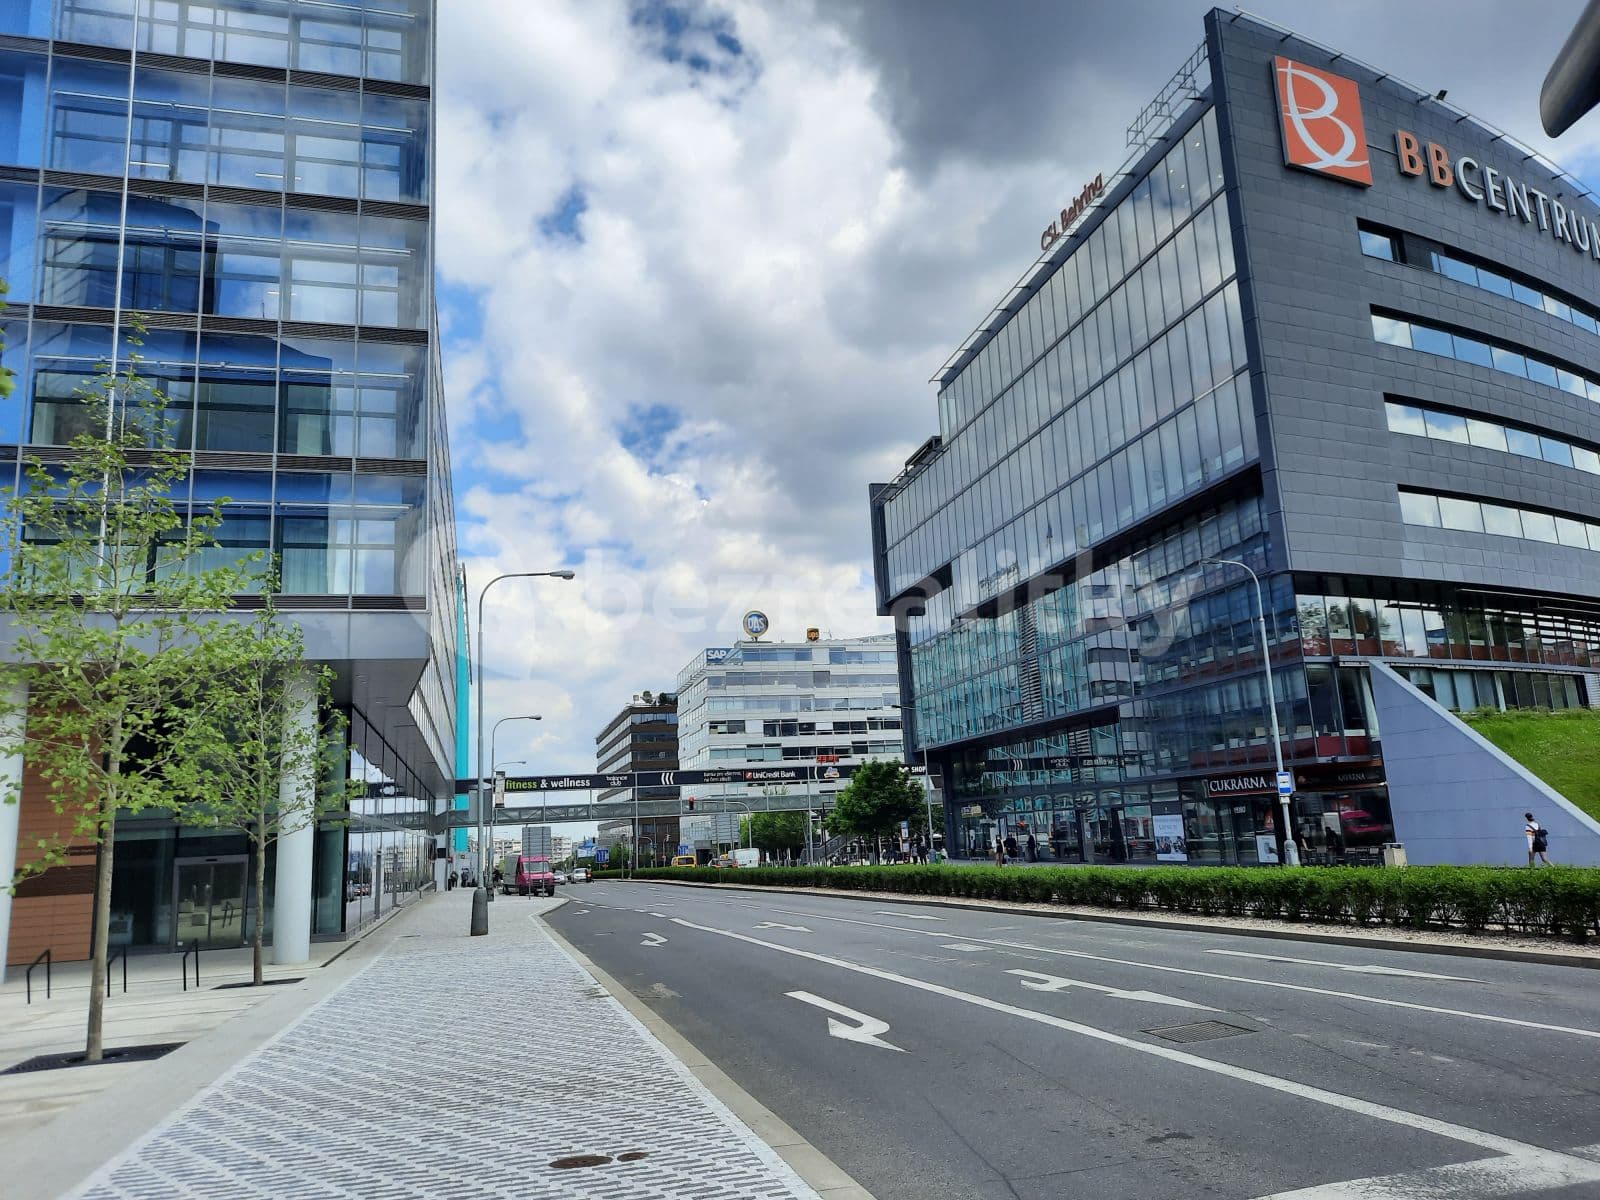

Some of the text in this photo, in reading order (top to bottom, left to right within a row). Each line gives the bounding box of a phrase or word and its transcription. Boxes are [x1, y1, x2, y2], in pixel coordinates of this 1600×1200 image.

[1041, 221, 1061, 251] CSL
[707, 650, 727, 660] SAP
[753, 770, 796, 779] UniCredit Bank
[505, 777, 591, 790] fitness & wellness
[1209, 776, 1267, 792] CUKRÁRNA
